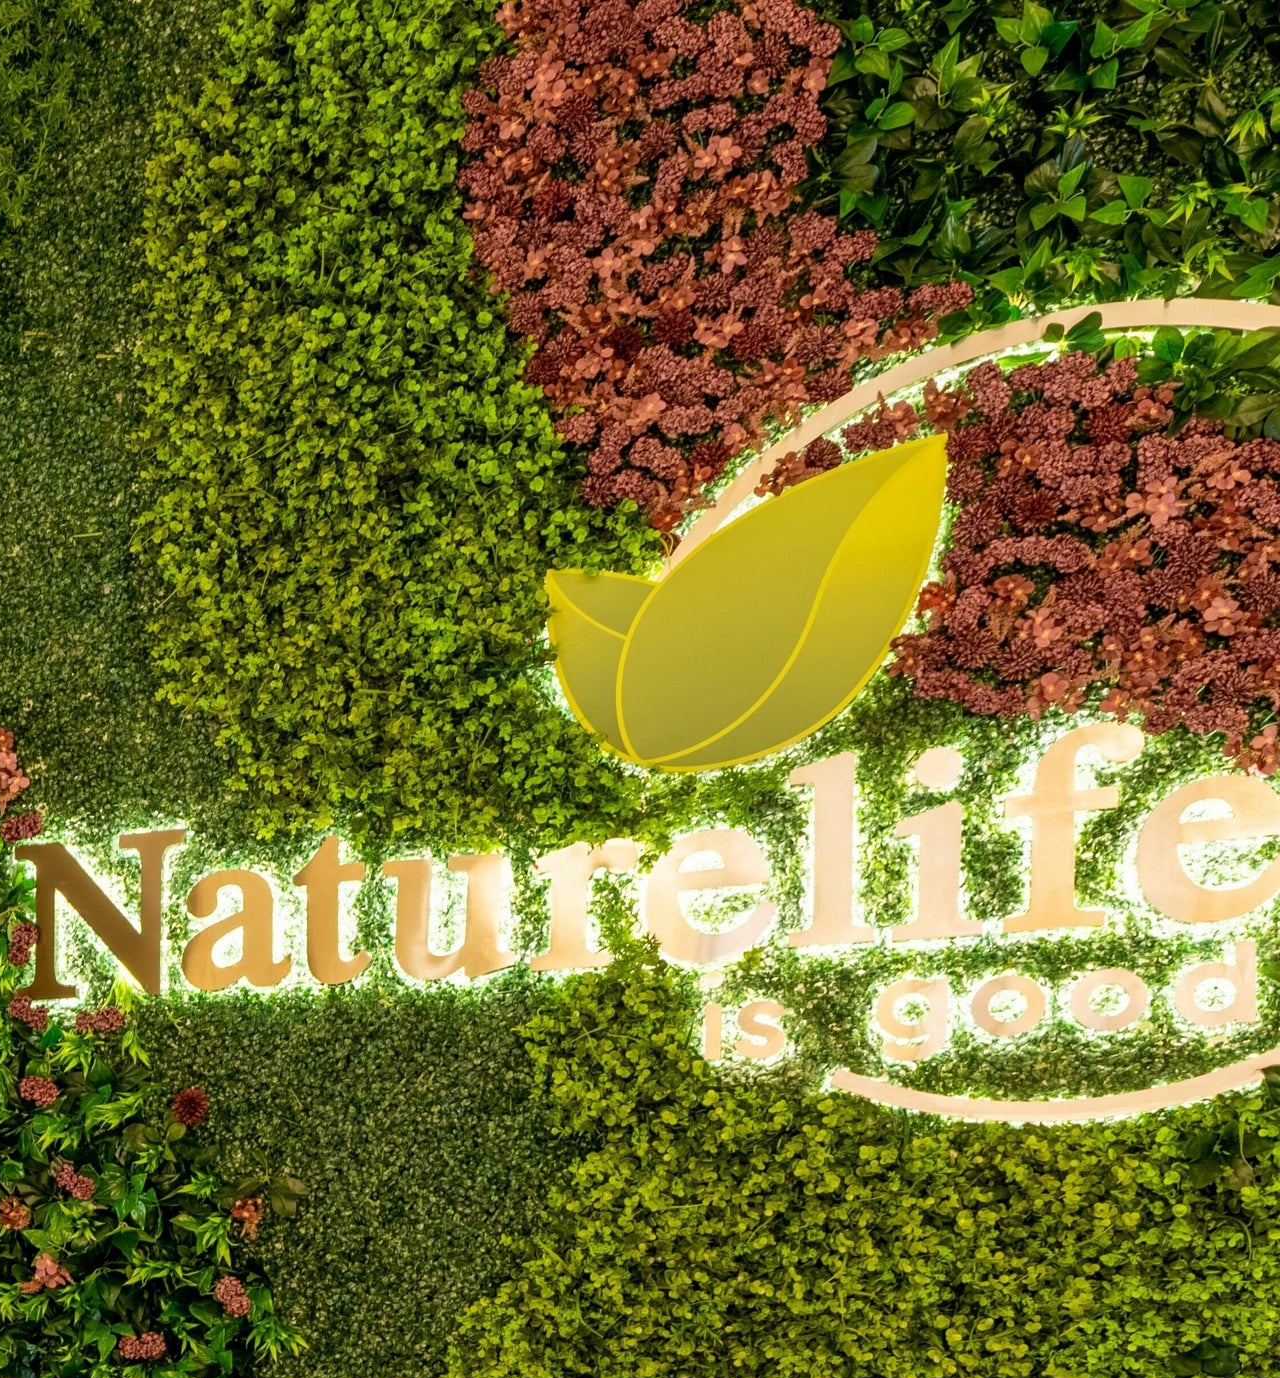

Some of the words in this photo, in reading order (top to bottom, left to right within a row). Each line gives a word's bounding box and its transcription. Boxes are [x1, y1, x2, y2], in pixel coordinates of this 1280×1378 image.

[14, 721, 1280, 1001] Naturelife
[703, 970, 787, 1061] is
[875, 941, 1257, 1061] good
